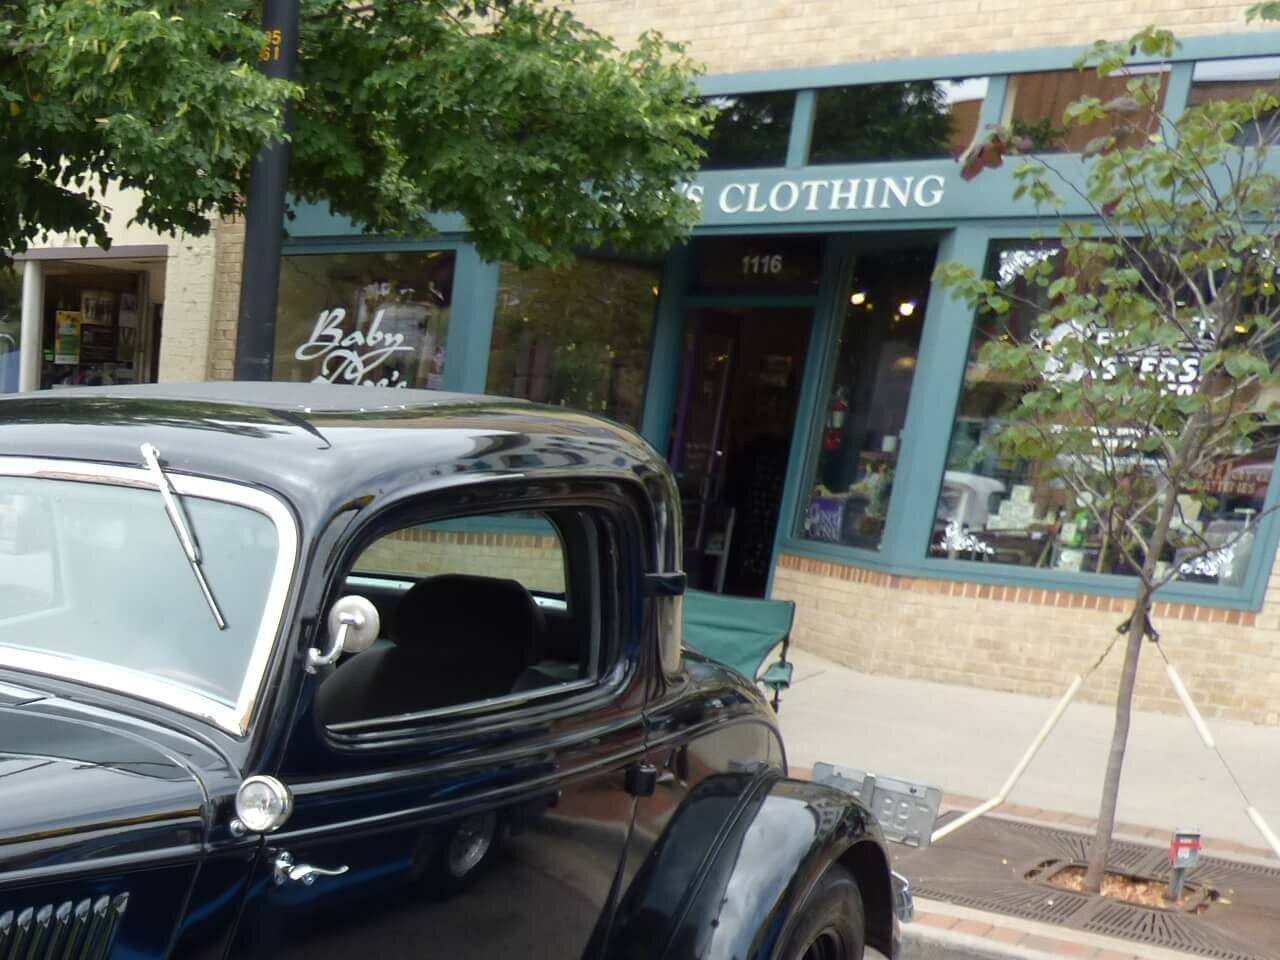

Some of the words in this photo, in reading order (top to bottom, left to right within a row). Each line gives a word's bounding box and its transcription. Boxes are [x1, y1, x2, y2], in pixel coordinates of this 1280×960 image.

[718, 174, 945, 213] CLOTHING
[741, 255, 783, 274] 1116
[295, 308, 415, 375] Baby
